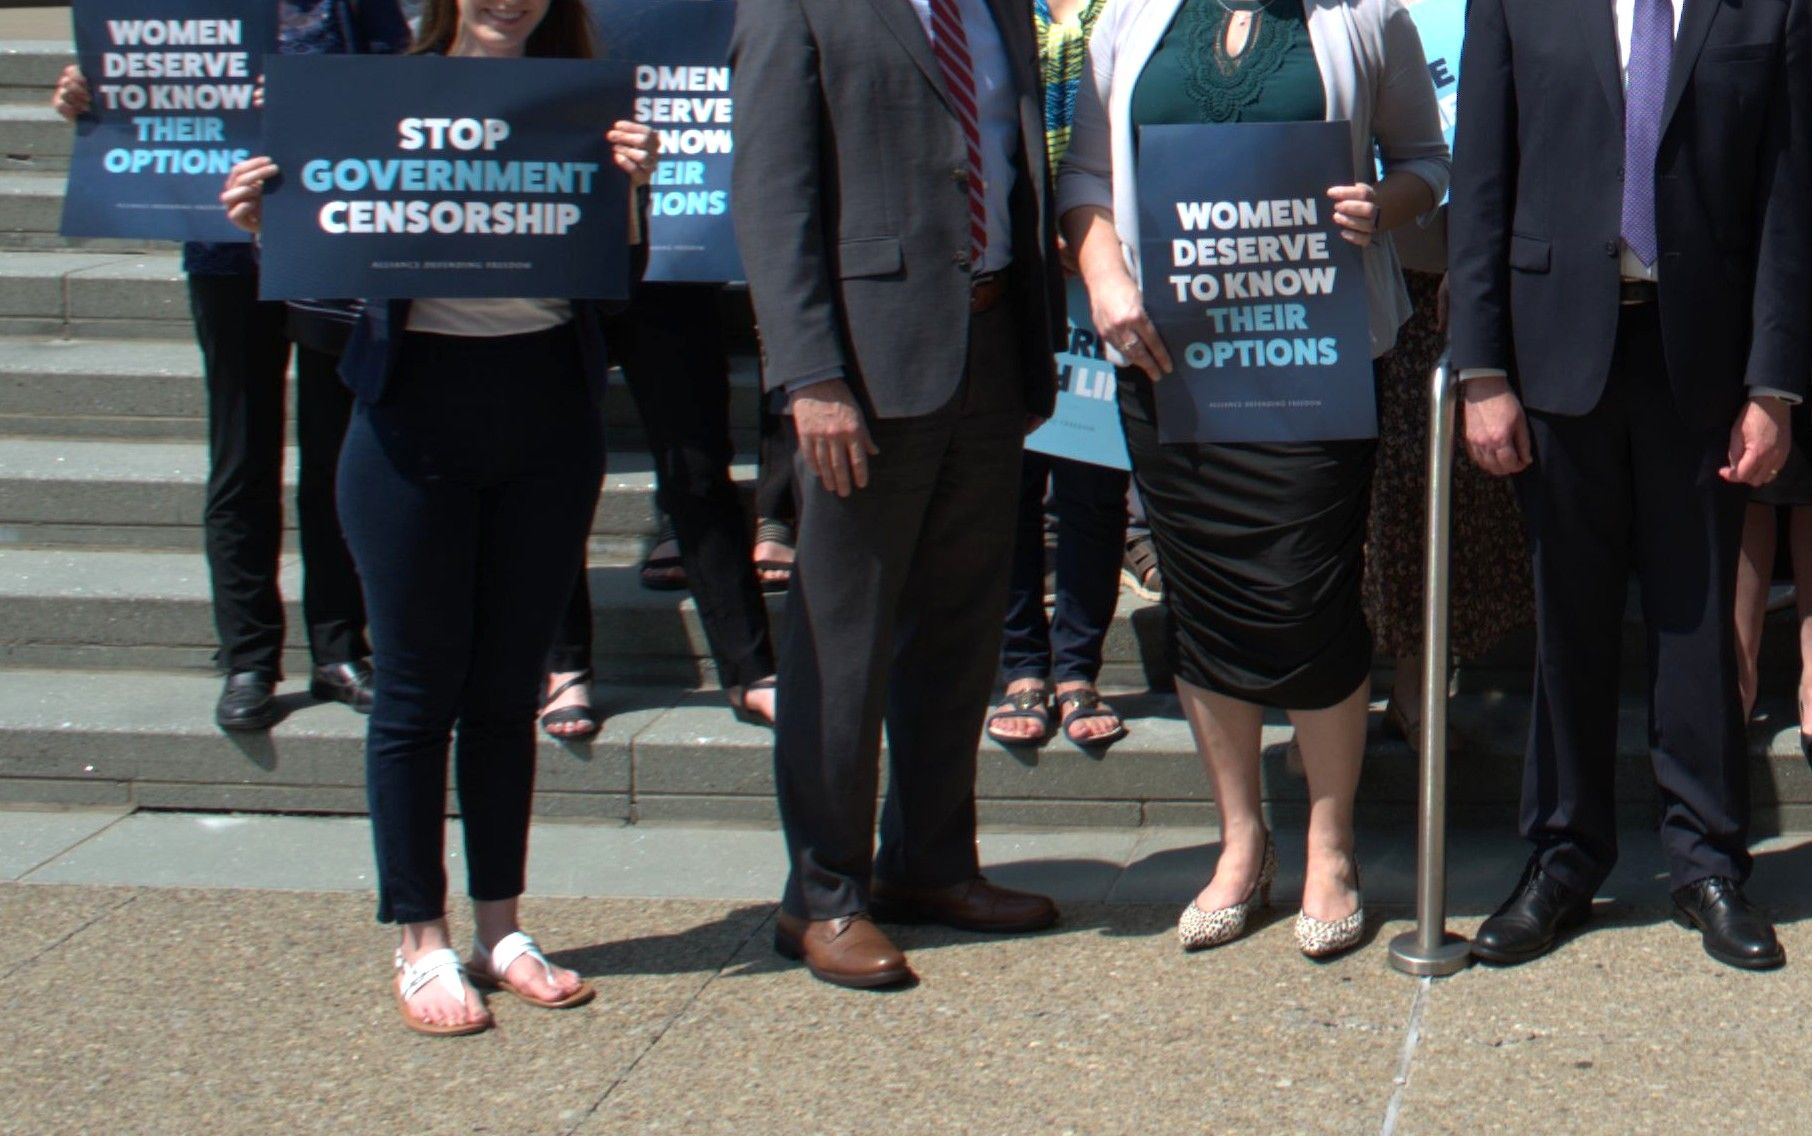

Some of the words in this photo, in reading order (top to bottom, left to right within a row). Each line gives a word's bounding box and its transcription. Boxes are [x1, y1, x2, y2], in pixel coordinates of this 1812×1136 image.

[107, 20, 241, 45] WOMEN
[103, 52, 248, 78] DESERVE
[635, 65, 729, 92] OMEN
[100, 85, 145, 109] TO
[151, 85, 253, 109] KNOW
[634, 97, 732, 123] SERVE
[133, 117, 224, 141] THEIR
[399, 118, 509, 150] STOP
[657, 129, 733, 154] NOW
[302, 159, 598, 193] GOVERNMENT
[650, 161, 705, 185] EIR
[319, 201, 581, 235] CENSORSHIP
[1176, 198, 1318, 231] WOMEN
[1172, 232, 1330, 268] DESERVE
[1169, 273, 1219, 303] TO
[1224, 267, 1338, 300] KNOW
[1206, 303, 1309, 335] THEIR
[1185, 337, 1338, 370] OPTIONS
